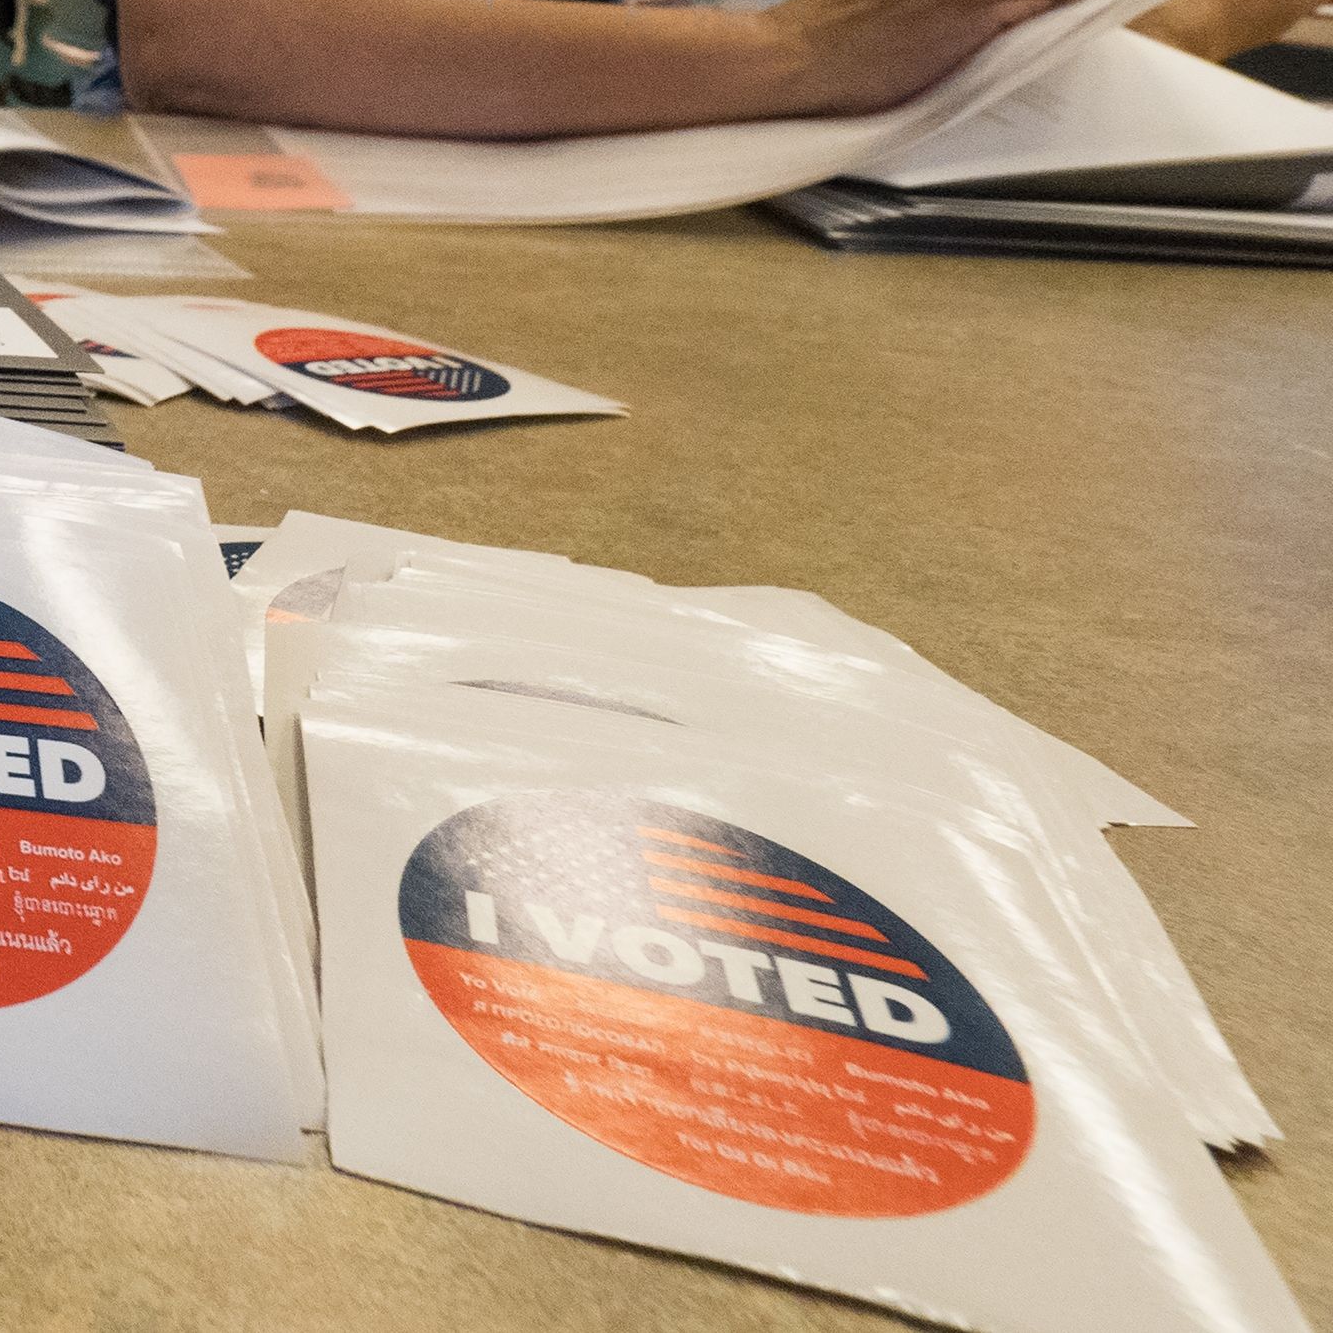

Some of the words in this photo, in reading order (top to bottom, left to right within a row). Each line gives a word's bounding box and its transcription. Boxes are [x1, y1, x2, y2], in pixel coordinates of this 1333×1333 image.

[304, 355, 443, 376] VOTED
[19, 839, 86, 862] Bumoto
[88, 849, 123, 866] Ako
[465, 889, 499, 945] I
[525, 902, 951, 1045] VOTED
